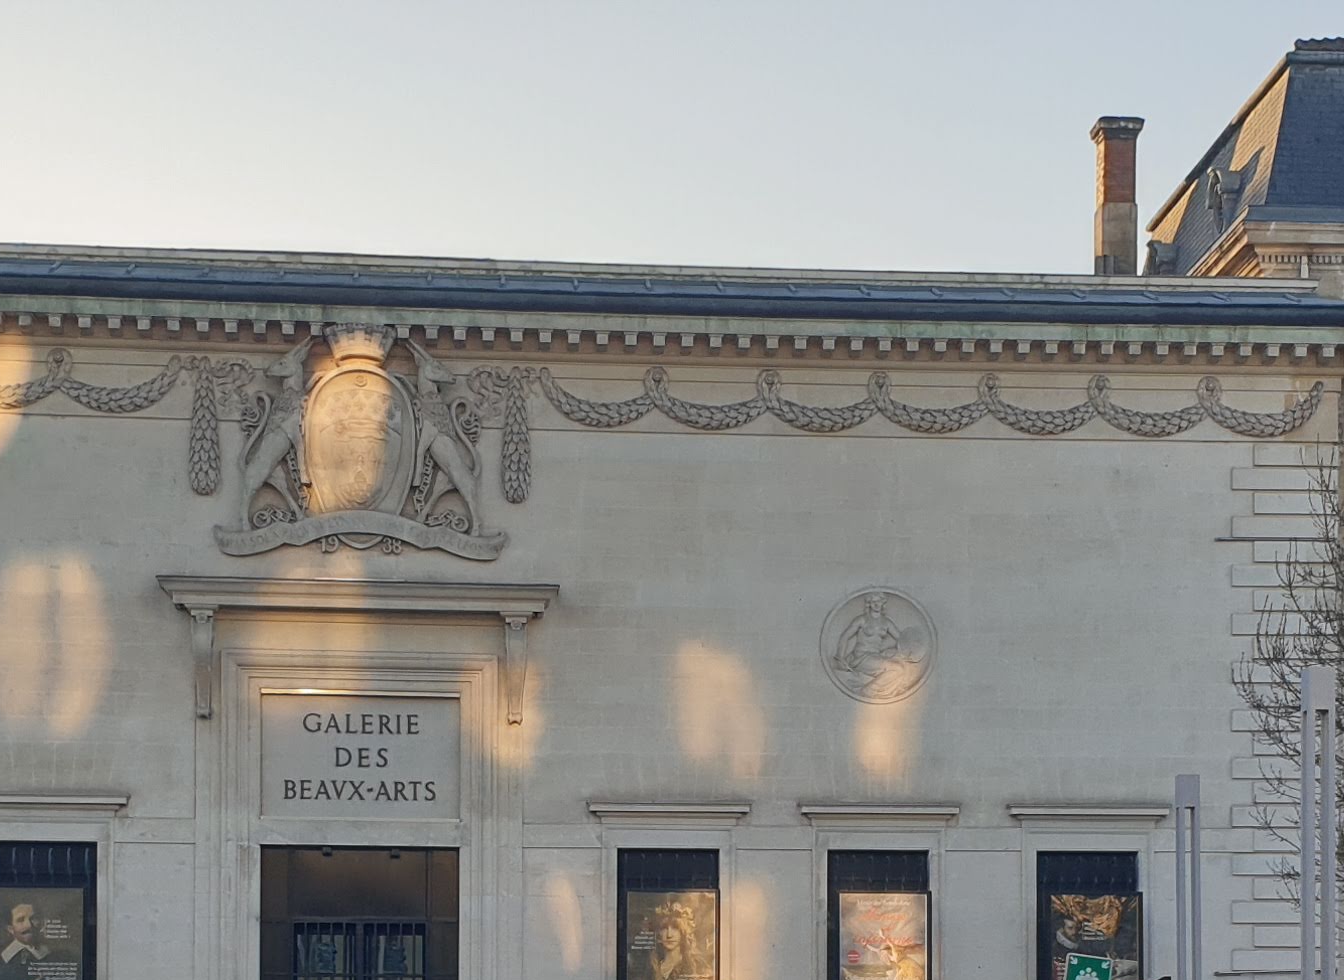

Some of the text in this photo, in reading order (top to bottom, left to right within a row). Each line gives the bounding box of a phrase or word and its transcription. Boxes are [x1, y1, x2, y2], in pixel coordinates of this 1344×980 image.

[319, 536, 339, 553] 19
[382, 537, 403, 555] 38
[302, 713, 420, 735] GALERIE
[334, 747, 389, 768] DES
[283, 779, 437, 802] BEAVX-ARTS
